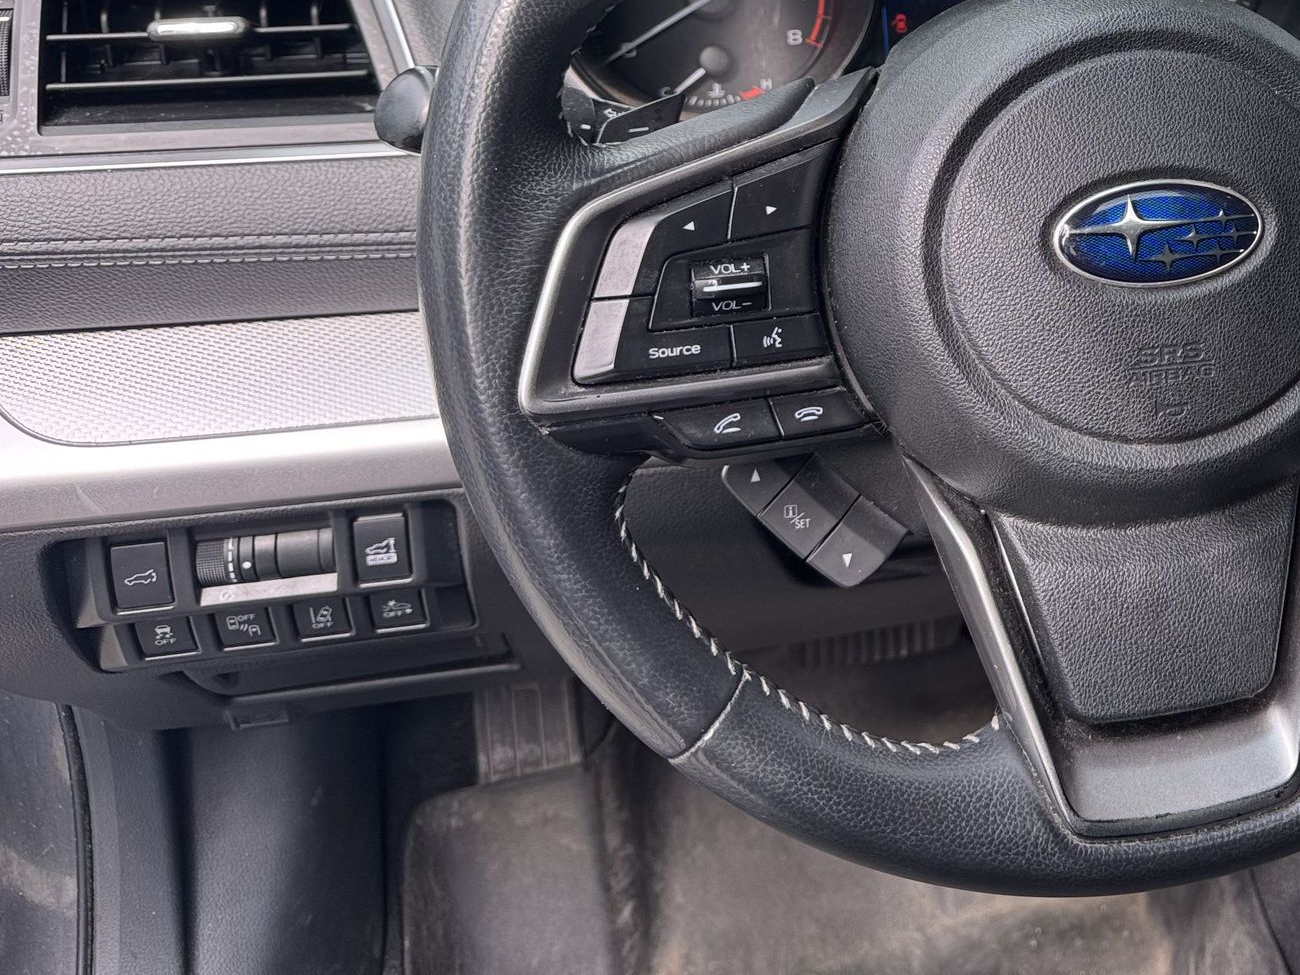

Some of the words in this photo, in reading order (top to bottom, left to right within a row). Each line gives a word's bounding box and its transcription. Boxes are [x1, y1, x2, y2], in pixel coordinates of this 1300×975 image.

[787, 29, 804, 46] 8
[760, 77, 773, 90] H
[648, 343, 701, 359] Source
[1137, 343, 1204, 366] SRS
[1128, 364, 1216, 387] AIRBAG
[794, 518, 811, 529] SET
[237, 613, 256, 622] OFF
[382, 610, 404, 618] OFF
[312, 621, 334, 629] OFF
[155, 638, 177, 646] OFF
